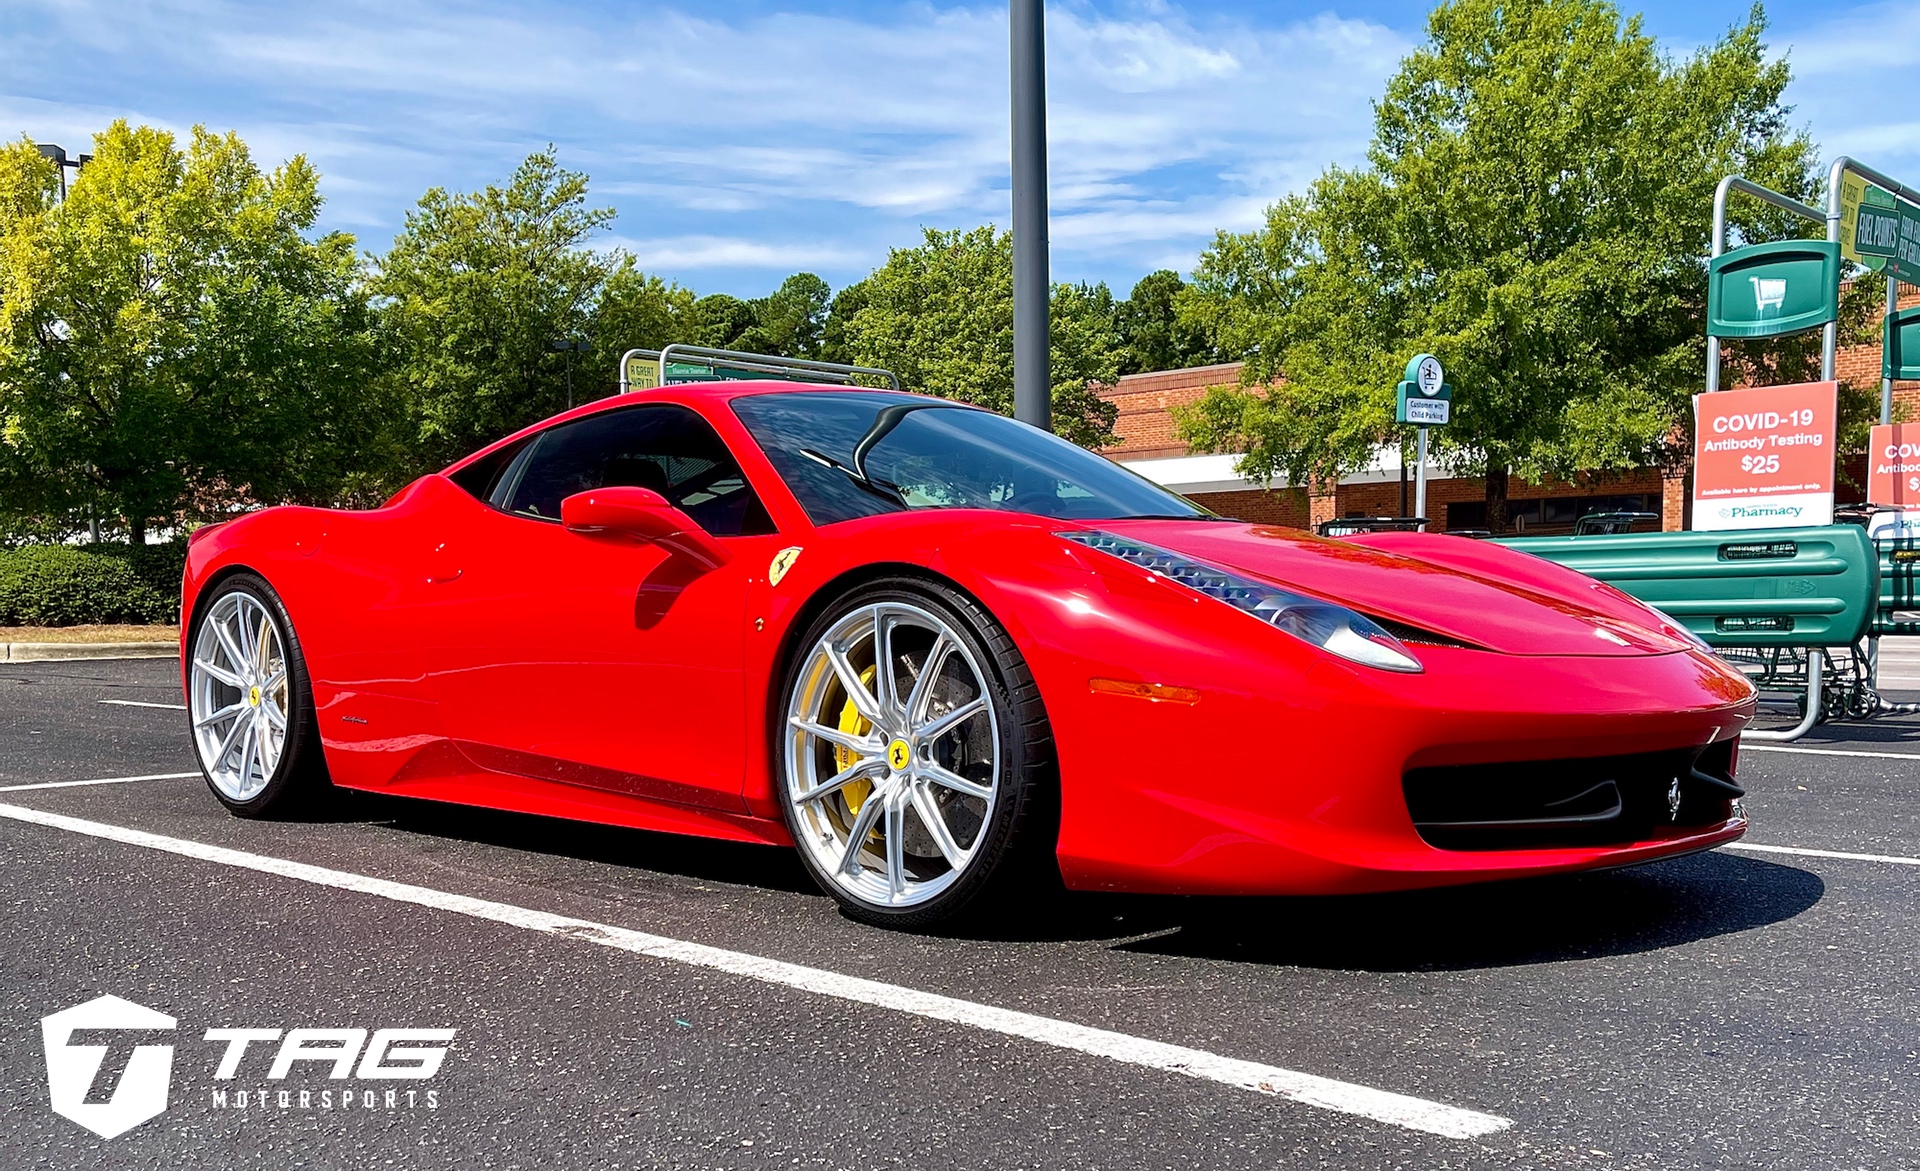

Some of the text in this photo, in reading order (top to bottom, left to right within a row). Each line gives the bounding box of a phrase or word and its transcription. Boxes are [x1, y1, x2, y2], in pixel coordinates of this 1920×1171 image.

[1857, 212, 1898, 248] FUEL POINTS
[630, 365, 654, 377] A GREAT
[631, 377, 645, 388] WAY
[1410, 400, 1434, 409] Customer
[1411, 410, 1443, 421] Child Parking
[1713, 408, 1814, 433] COVID-19
[1703, 432, 1823, 452] Antibody Testing
[1741, 454, 1780, 474] $25
[1702, 488, 1731, 496] Available
[1749, 486, 1758, 494] by
[1759, 484, 1803, 493] appointment
[1732, 506, 1804, 518] Pharmacy
